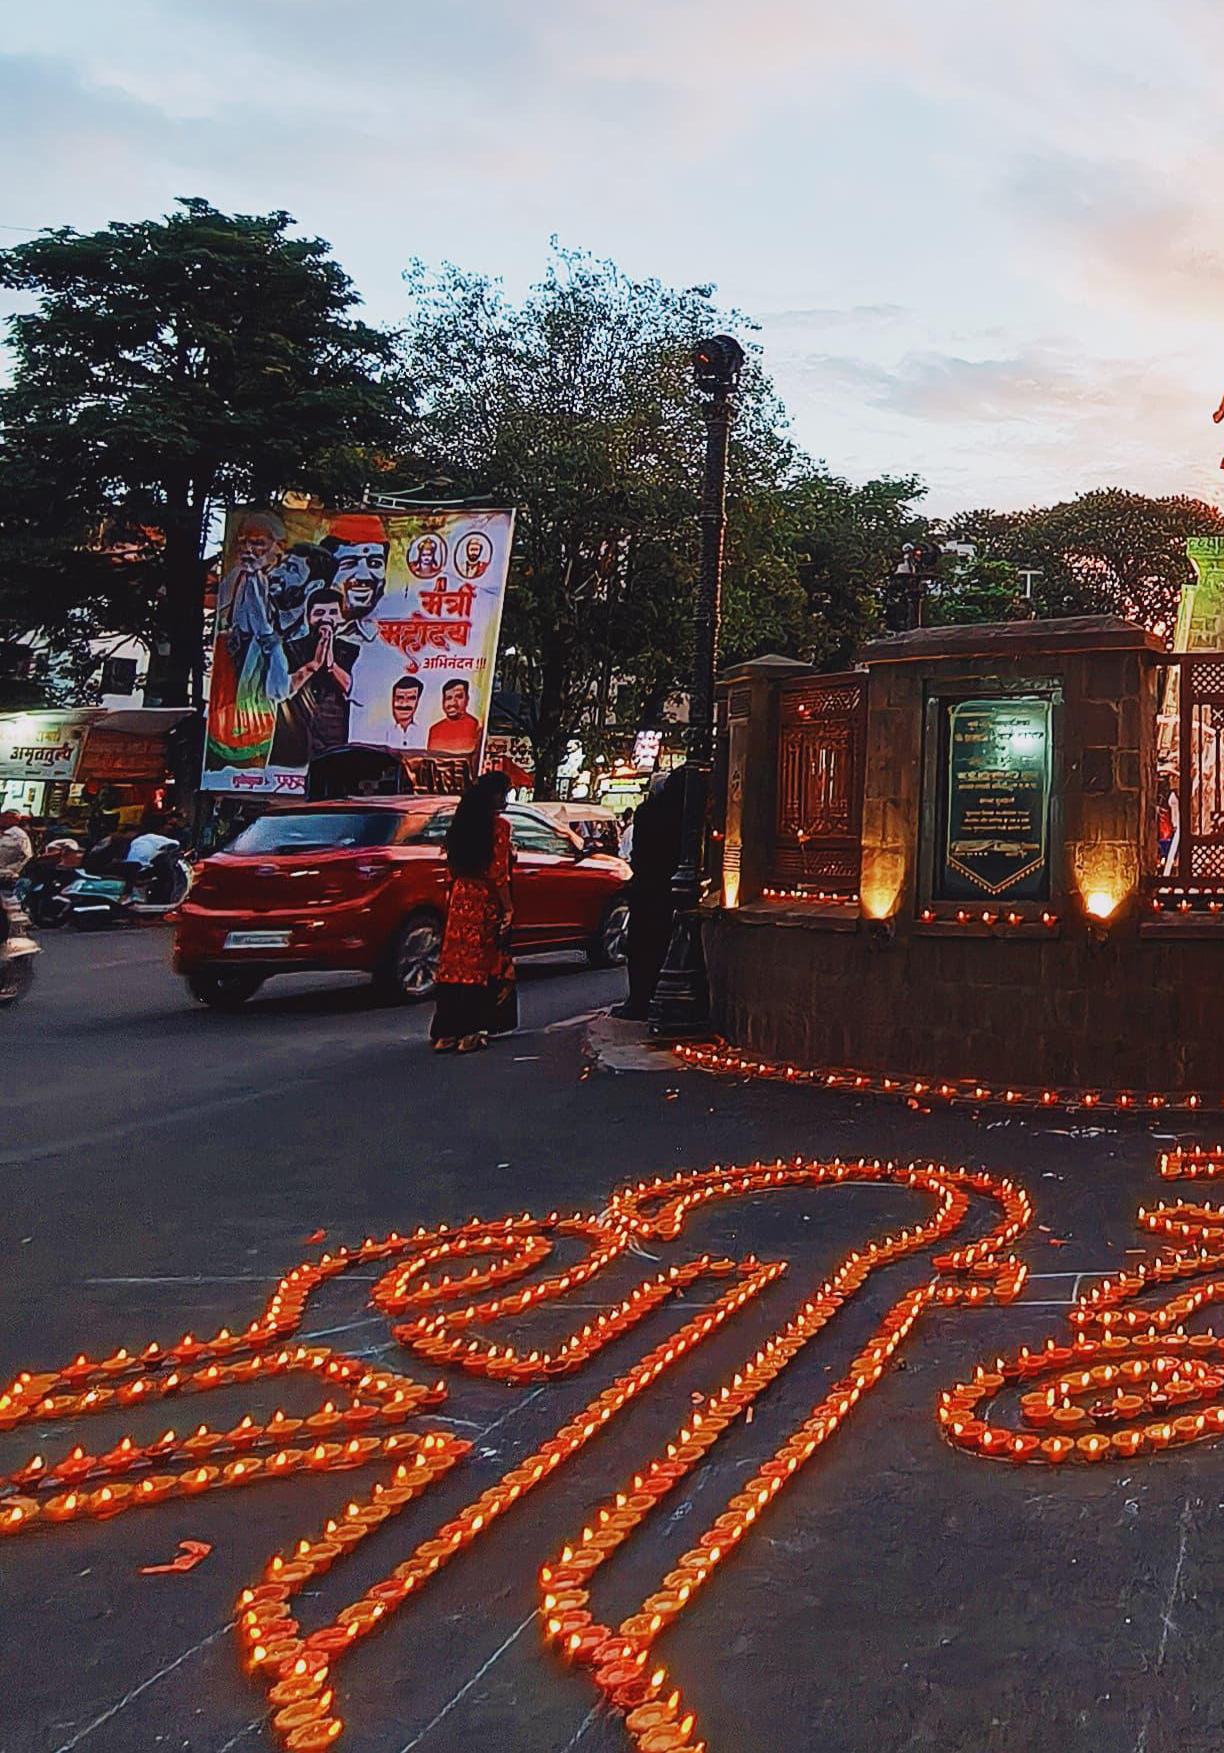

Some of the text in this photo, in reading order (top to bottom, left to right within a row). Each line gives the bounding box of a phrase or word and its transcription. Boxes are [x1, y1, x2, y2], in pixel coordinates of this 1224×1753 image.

[418, 577, 477, 617] मंत्री
[377, 611, 472, 668] महोदय
[422, 654, 474, 670] अभिनंदन
